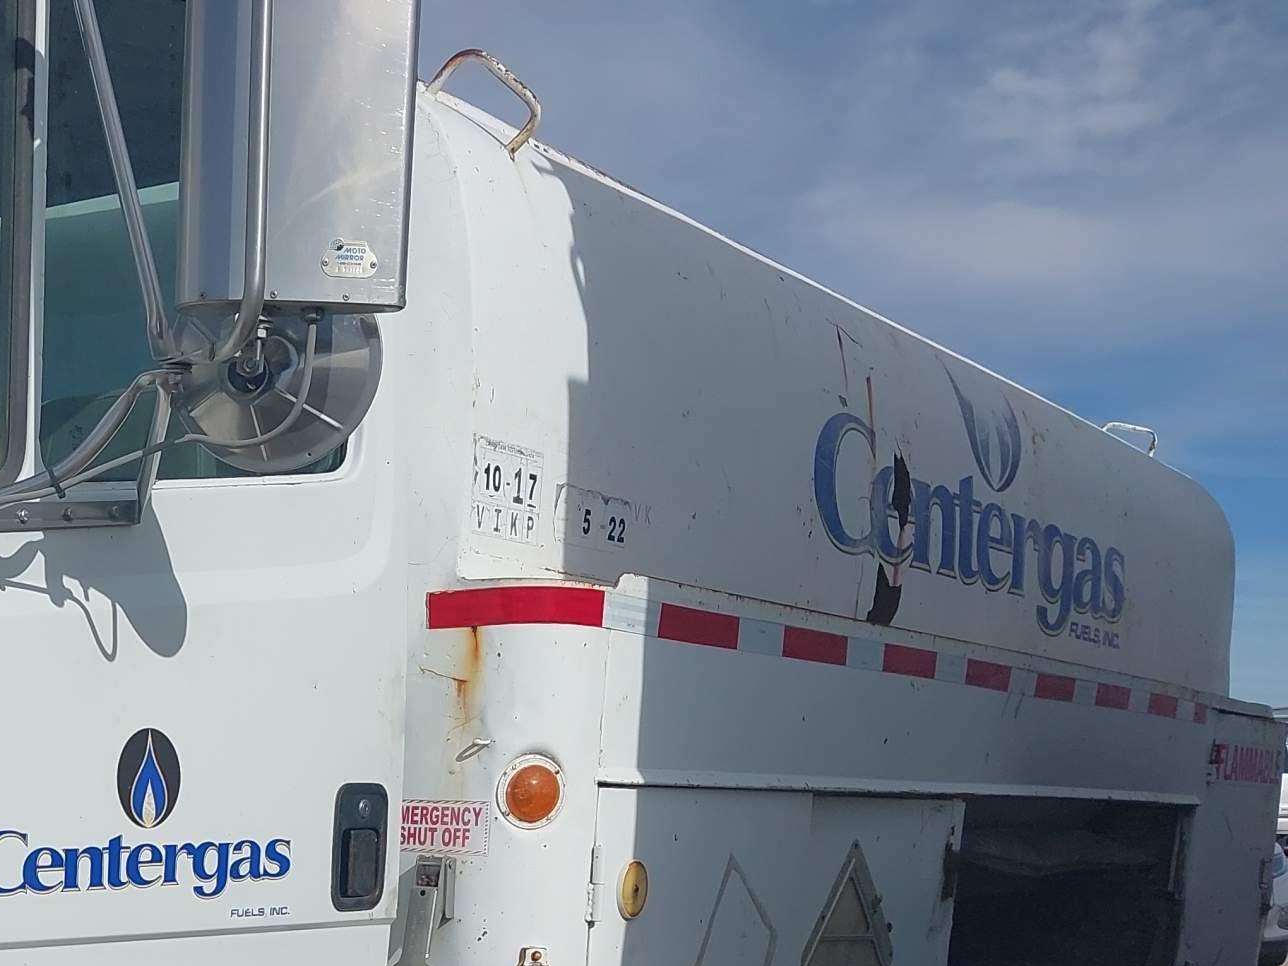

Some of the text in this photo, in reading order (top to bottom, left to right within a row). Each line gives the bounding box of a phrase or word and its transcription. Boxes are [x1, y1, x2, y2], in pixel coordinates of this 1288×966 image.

[814, 412, 1126, 638] Centergas
[402, 806, 482, 827] MERGENCY
[441, 827, 471, 848] OFF
[269, 905, 291, 916] INC.
